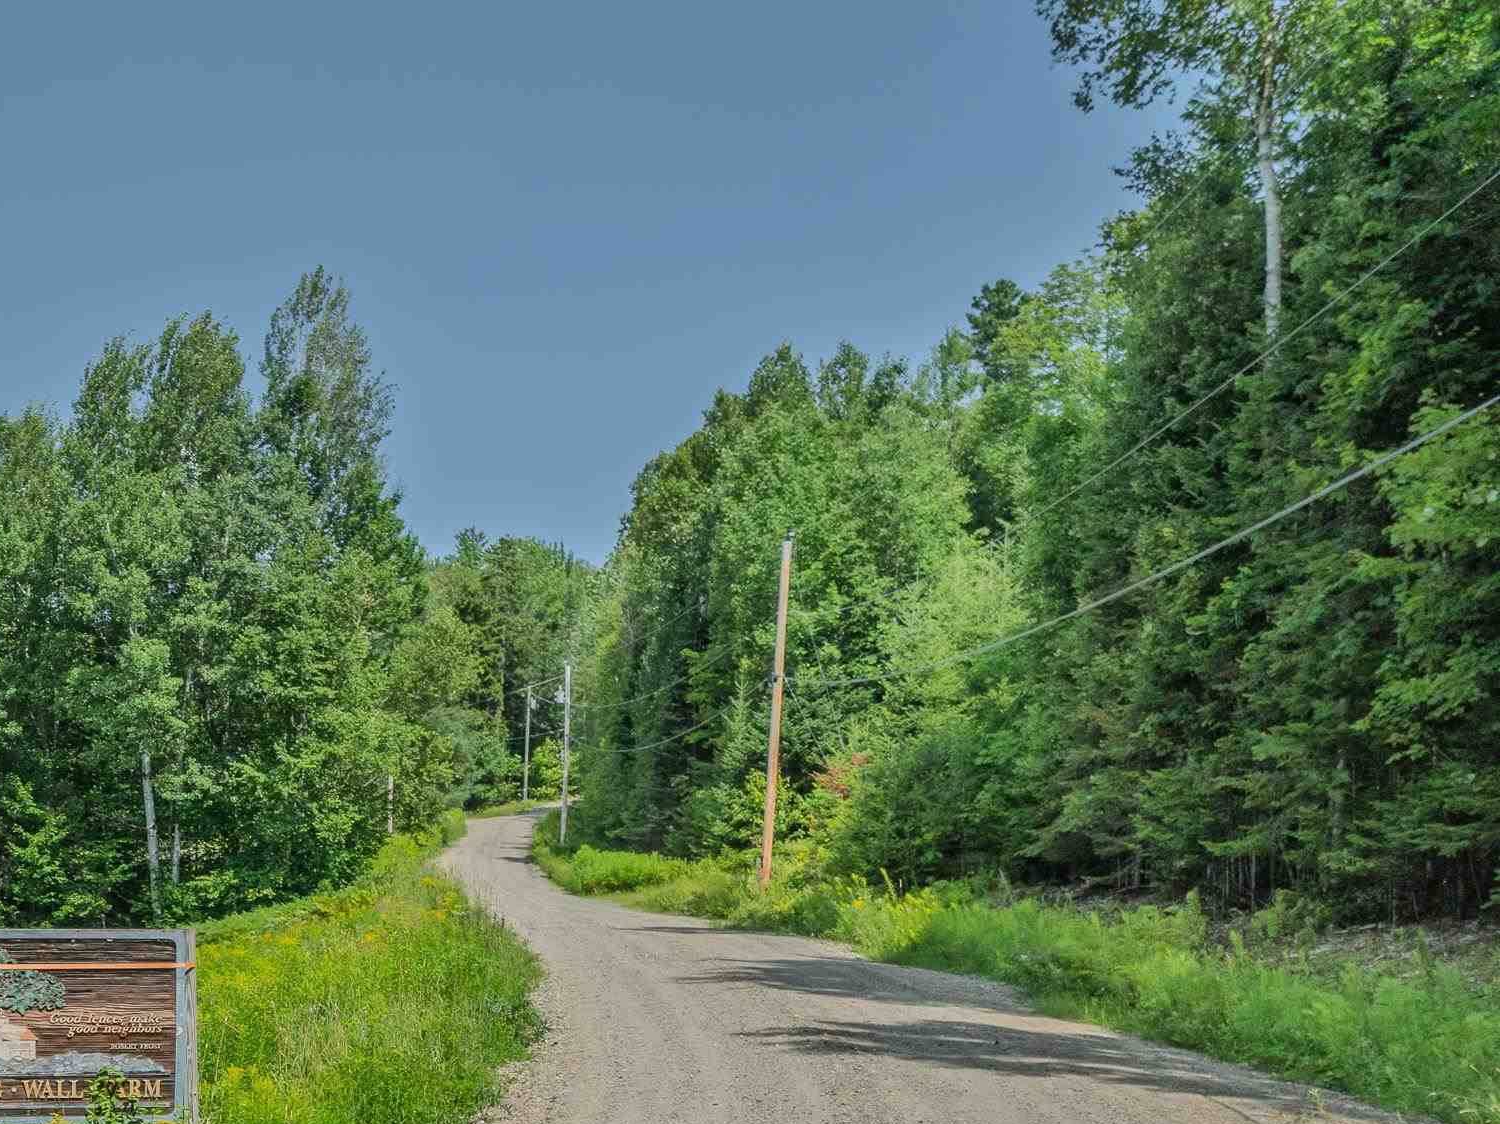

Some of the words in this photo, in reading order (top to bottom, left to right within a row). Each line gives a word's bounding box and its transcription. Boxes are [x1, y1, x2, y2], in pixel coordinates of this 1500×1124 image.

[50, 1012, 83, 1024] Good
[129, 1013, 164, 1024] make
[67, 1022, 98, 1038] good
[104, 1022, 164, 1038] neighbors
[20, 1079, 84, 1099] WALL
